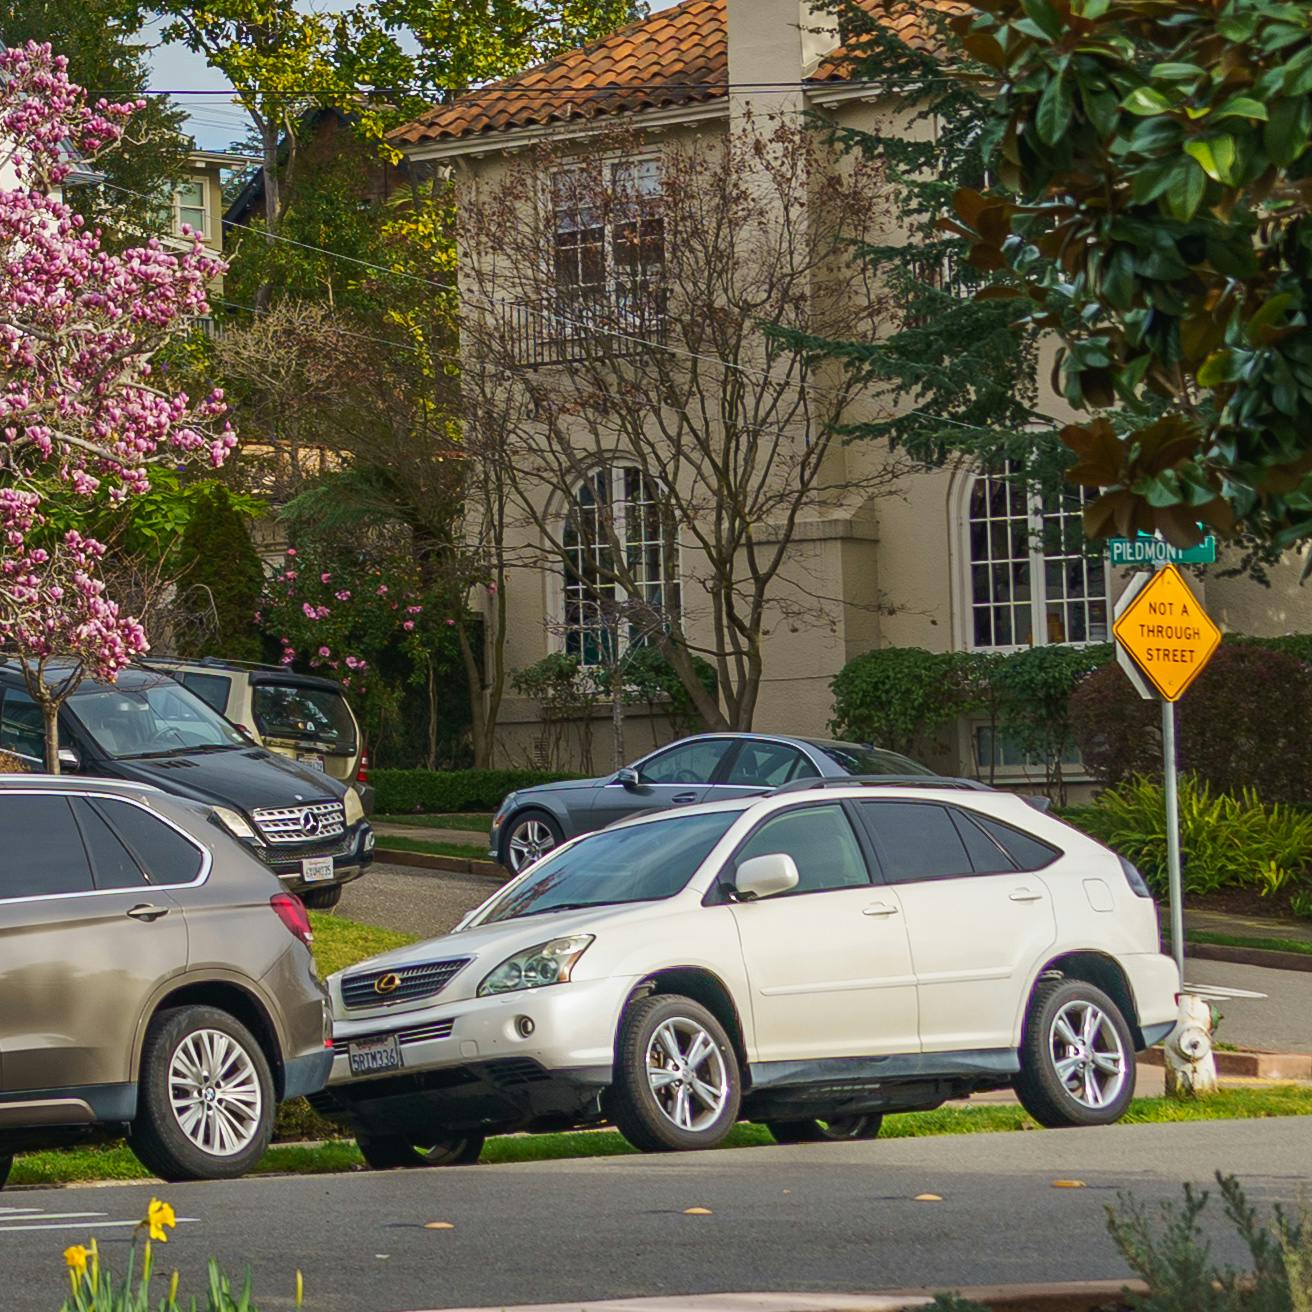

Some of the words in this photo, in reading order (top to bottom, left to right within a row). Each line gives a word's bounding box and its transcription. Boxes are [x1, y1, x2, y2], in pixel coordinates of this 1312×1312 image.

[1149, 602, 1174, 616] NOT
[1181, 603, 1189, 616] A
[1139, 624, 1201, 640] THROUGH
[1146, 648, 1194, 663] STREET
